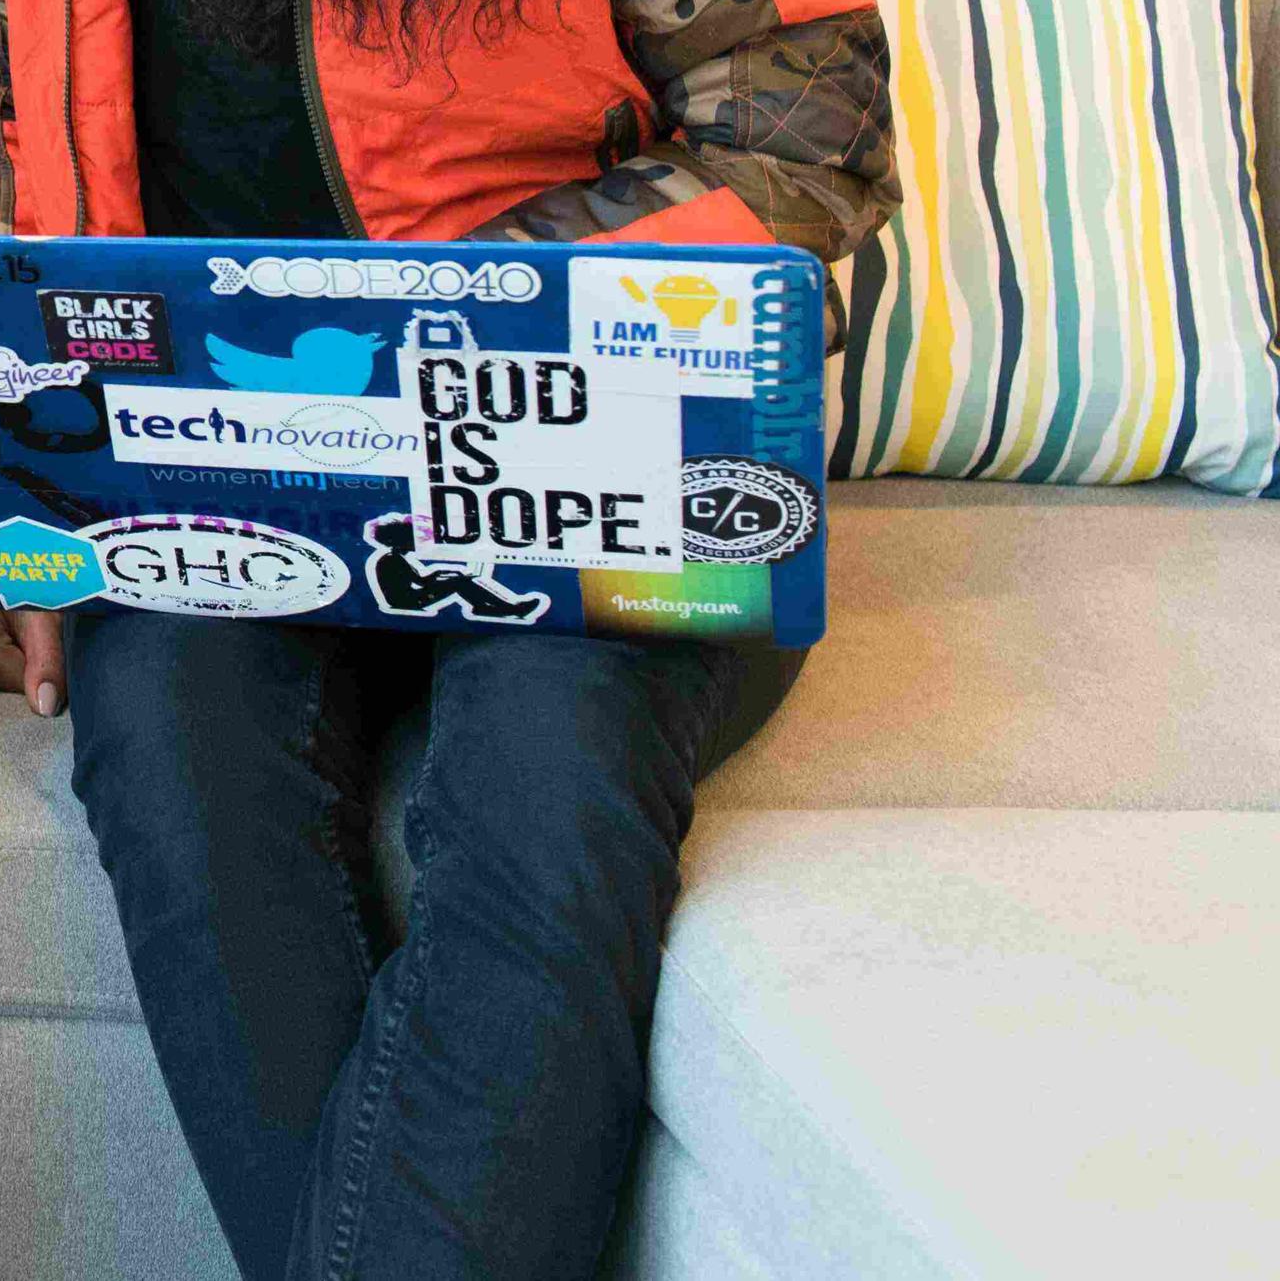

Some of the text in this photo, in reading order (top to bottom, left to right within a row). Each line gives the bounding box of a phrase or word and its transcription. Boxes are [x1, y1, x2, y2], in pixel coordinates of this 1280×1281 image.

[249, 260, 536, 299] CODE2040
[53, 296, 155, 320] BLACK
[66, 319, 151, 340] GIRLS
[593, 320, 657, 343] I AM
[66, 340, 160, 361] CODE
[418, 358, 589, 425] GOD
[114, 407, 419, 452] technovation
[424, 421, 501, 486] IS
[735, 470, 786, 495] CRAFT
[430, 484, 672, 557] DOPE.
[105, 543, 296, 592] GHC
[611, 594, 744, 619] Instagram
